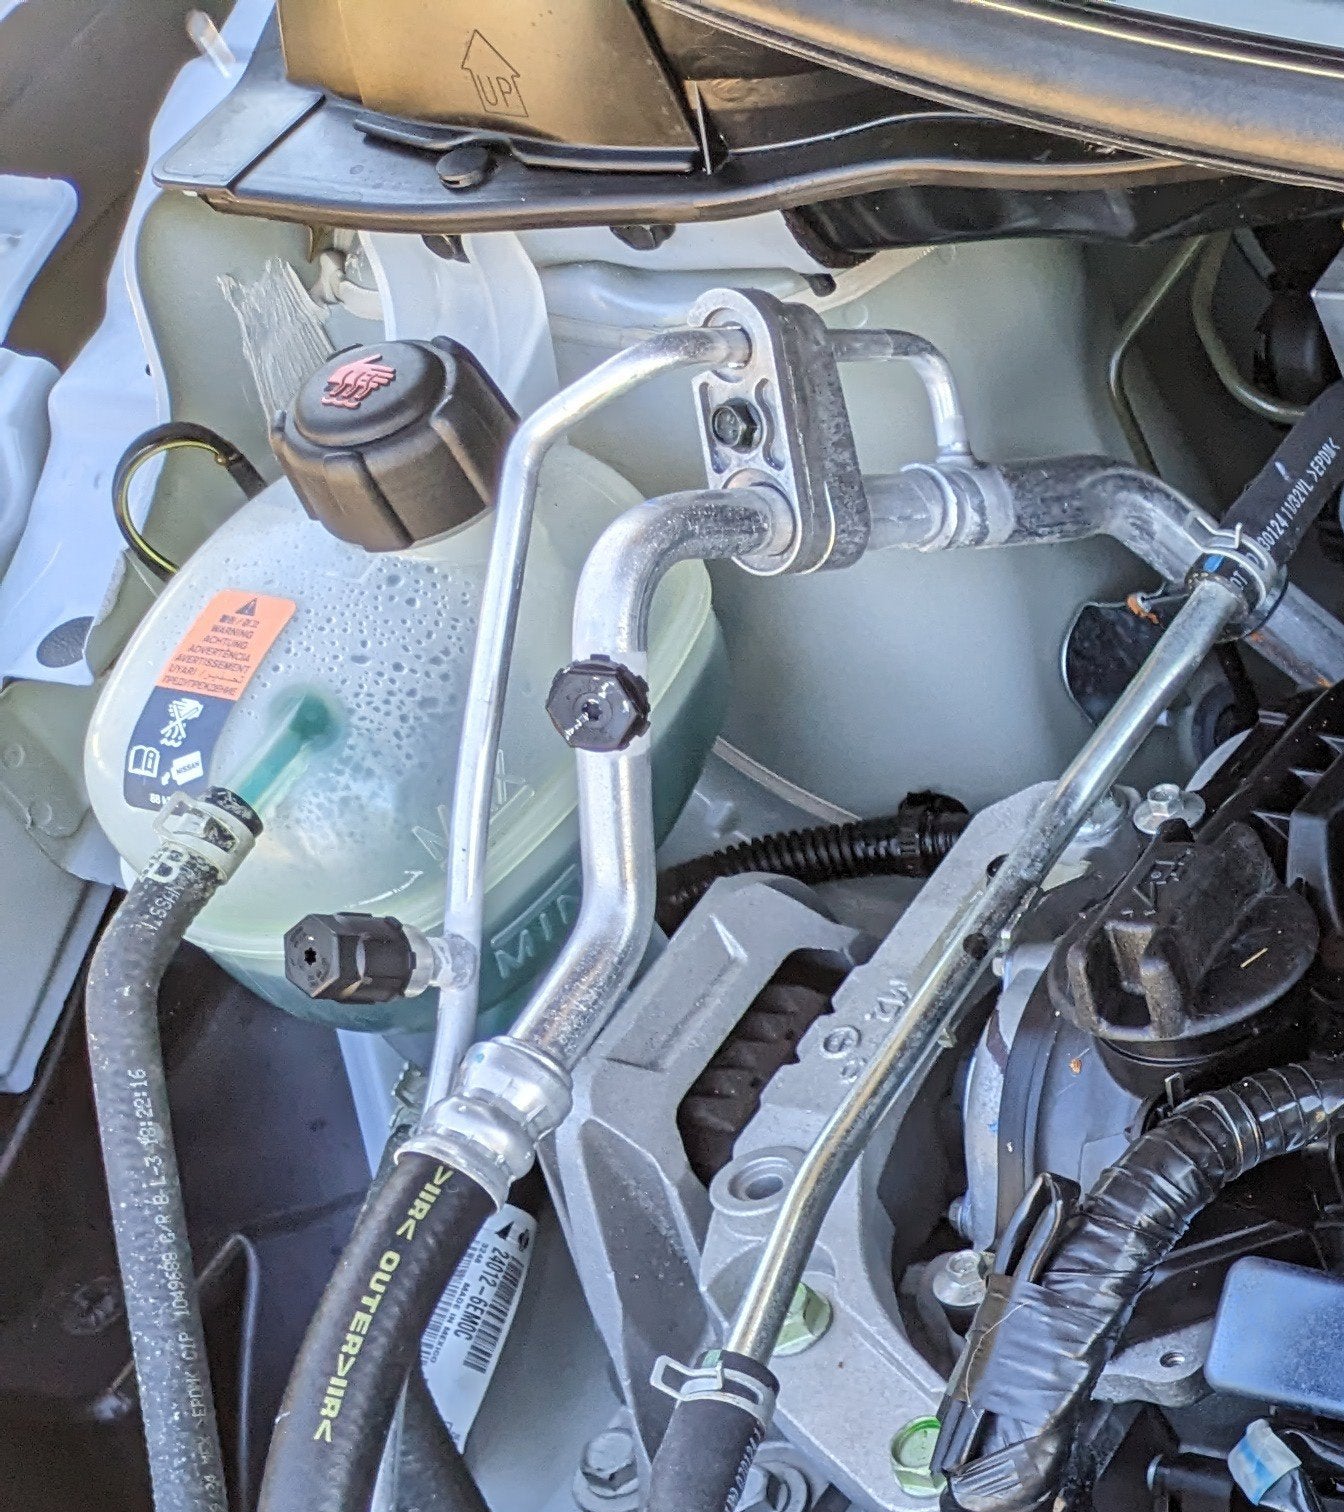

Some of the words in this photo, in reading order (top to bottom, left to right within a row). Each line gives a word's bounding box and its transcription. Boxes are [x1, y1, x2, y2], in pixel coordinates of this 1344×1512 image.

[477, 74, 512, 107] UP
[1256, 515, 1289, 550] 30124
[1307, 437, 1341, 483] >EPDM<
